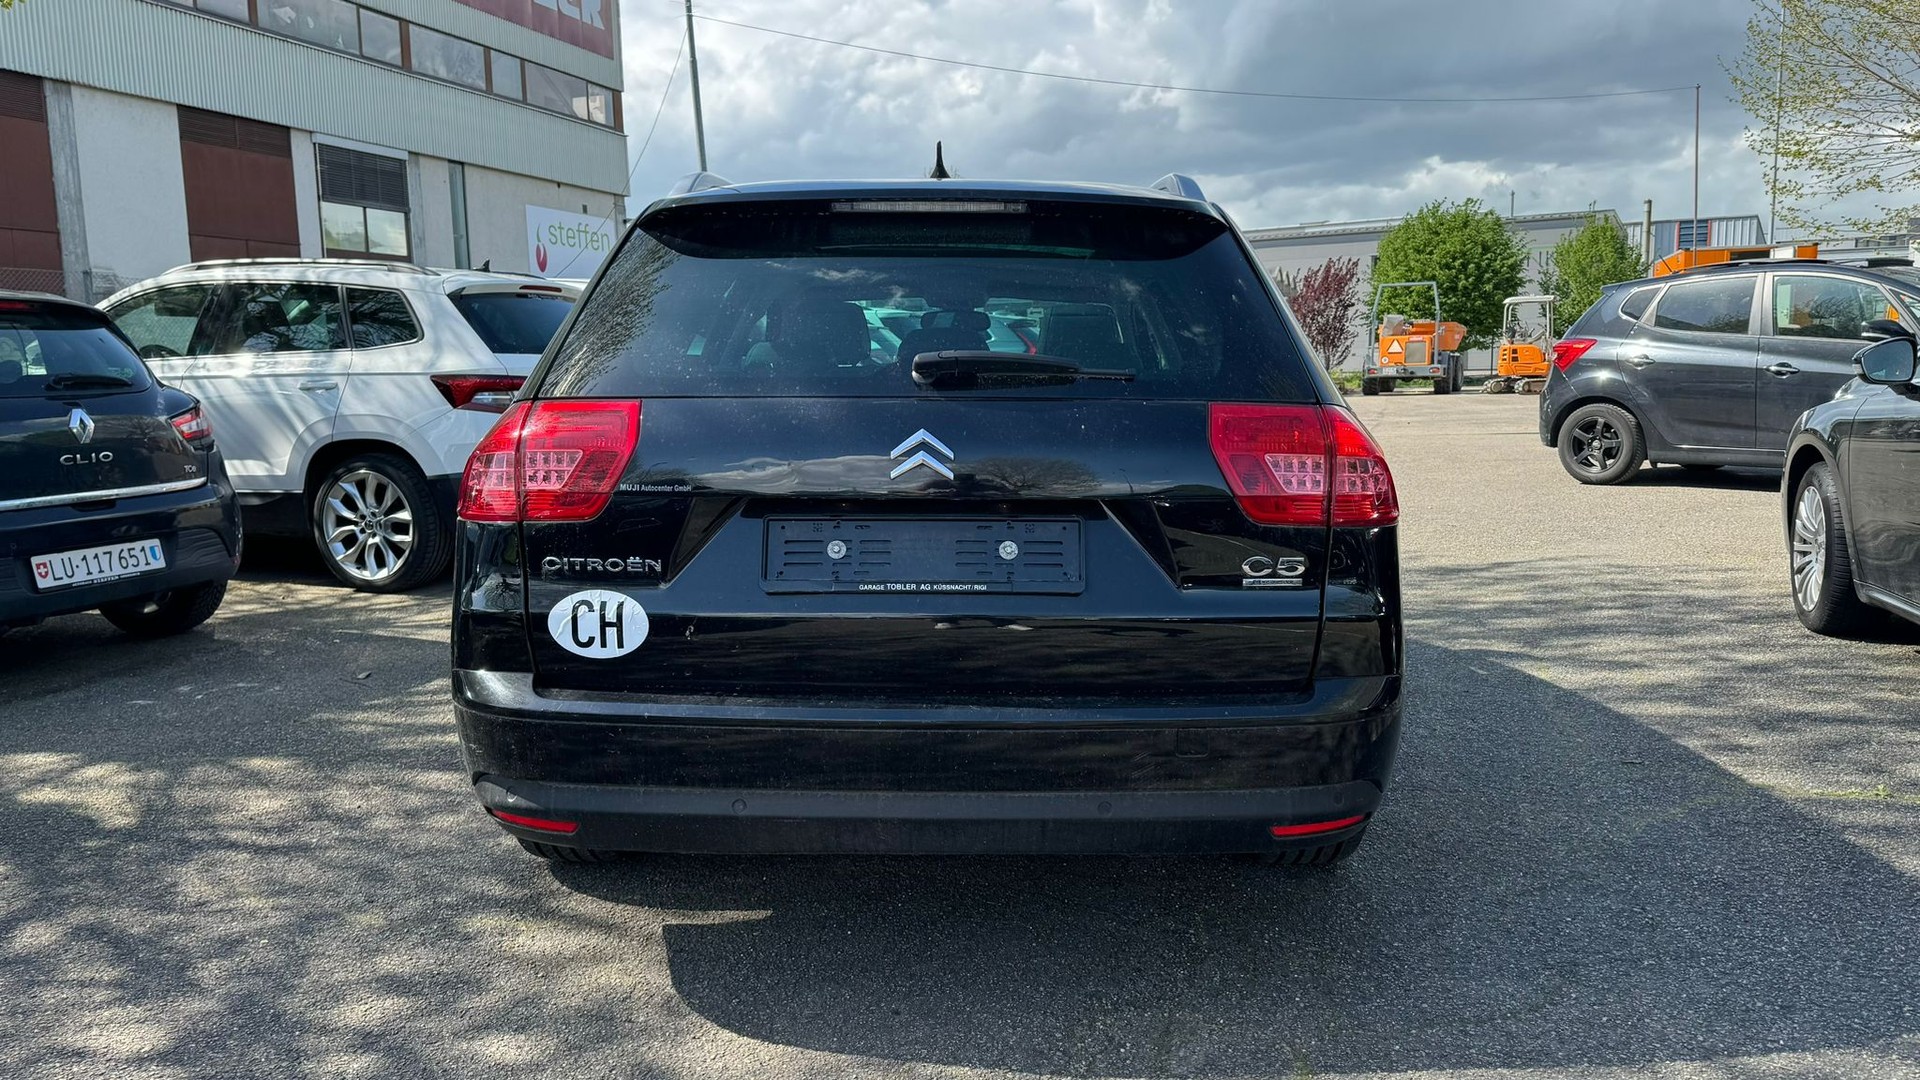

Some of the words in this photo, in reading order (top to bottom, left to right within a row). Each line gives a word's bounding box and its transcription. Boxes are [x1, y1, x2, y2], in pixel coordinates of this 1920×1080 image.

[548, 221, 611, 252] steffen
[59, 451, 114, 466] CLIO
[619, 484, 640, 492] MUJI
[641, 484, 674, 492] Autocenter
[674, 484, 692, 492] GmbH
[541, 556, 662, 572] CITROËN
[1241, 556, 1306, 577] C5
[886, 583, 917, 591] TOBLER
[919, 583, 931, 591] AG
[571, 599, 625, 650] CH
